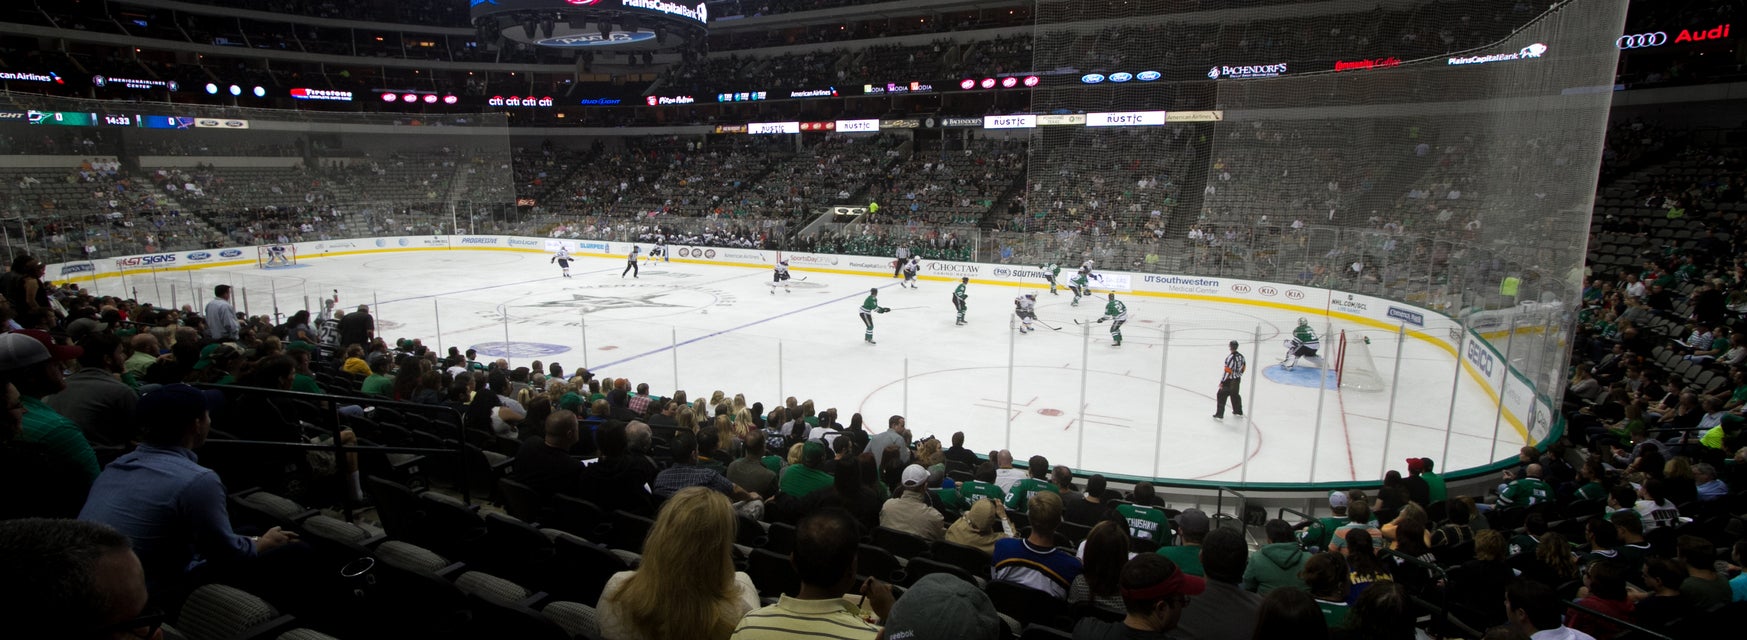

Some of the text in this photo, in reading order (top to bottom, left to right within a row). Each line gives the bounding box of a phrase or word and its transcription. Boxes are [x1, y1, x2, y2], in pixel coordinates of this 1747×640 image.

[1675, 24, 1730, 43] Audi
[17, 73, 51, 81] Airlines
[305, 89, 352, 97] Firestone
[489, 97, 503, 106] citi
[506, 97, 520, 106] citi
[522, 97, 536, 106] citi
[538, 97, 553, 106] citi
[55, 112, 63, 121] 0
[105, 117, 130, 125] 14:33
[932, 262, 979, 273] CHOCTAW
[1012, 269, 1046, 278] SOUTHWE
[1155, 276, 1219, 287] Southwestern
[320, 327, 337, 343] 25
[1467, 339, 1493, 378] GEICO
[1126, 517, 1159, 531] CHUSHKIN
